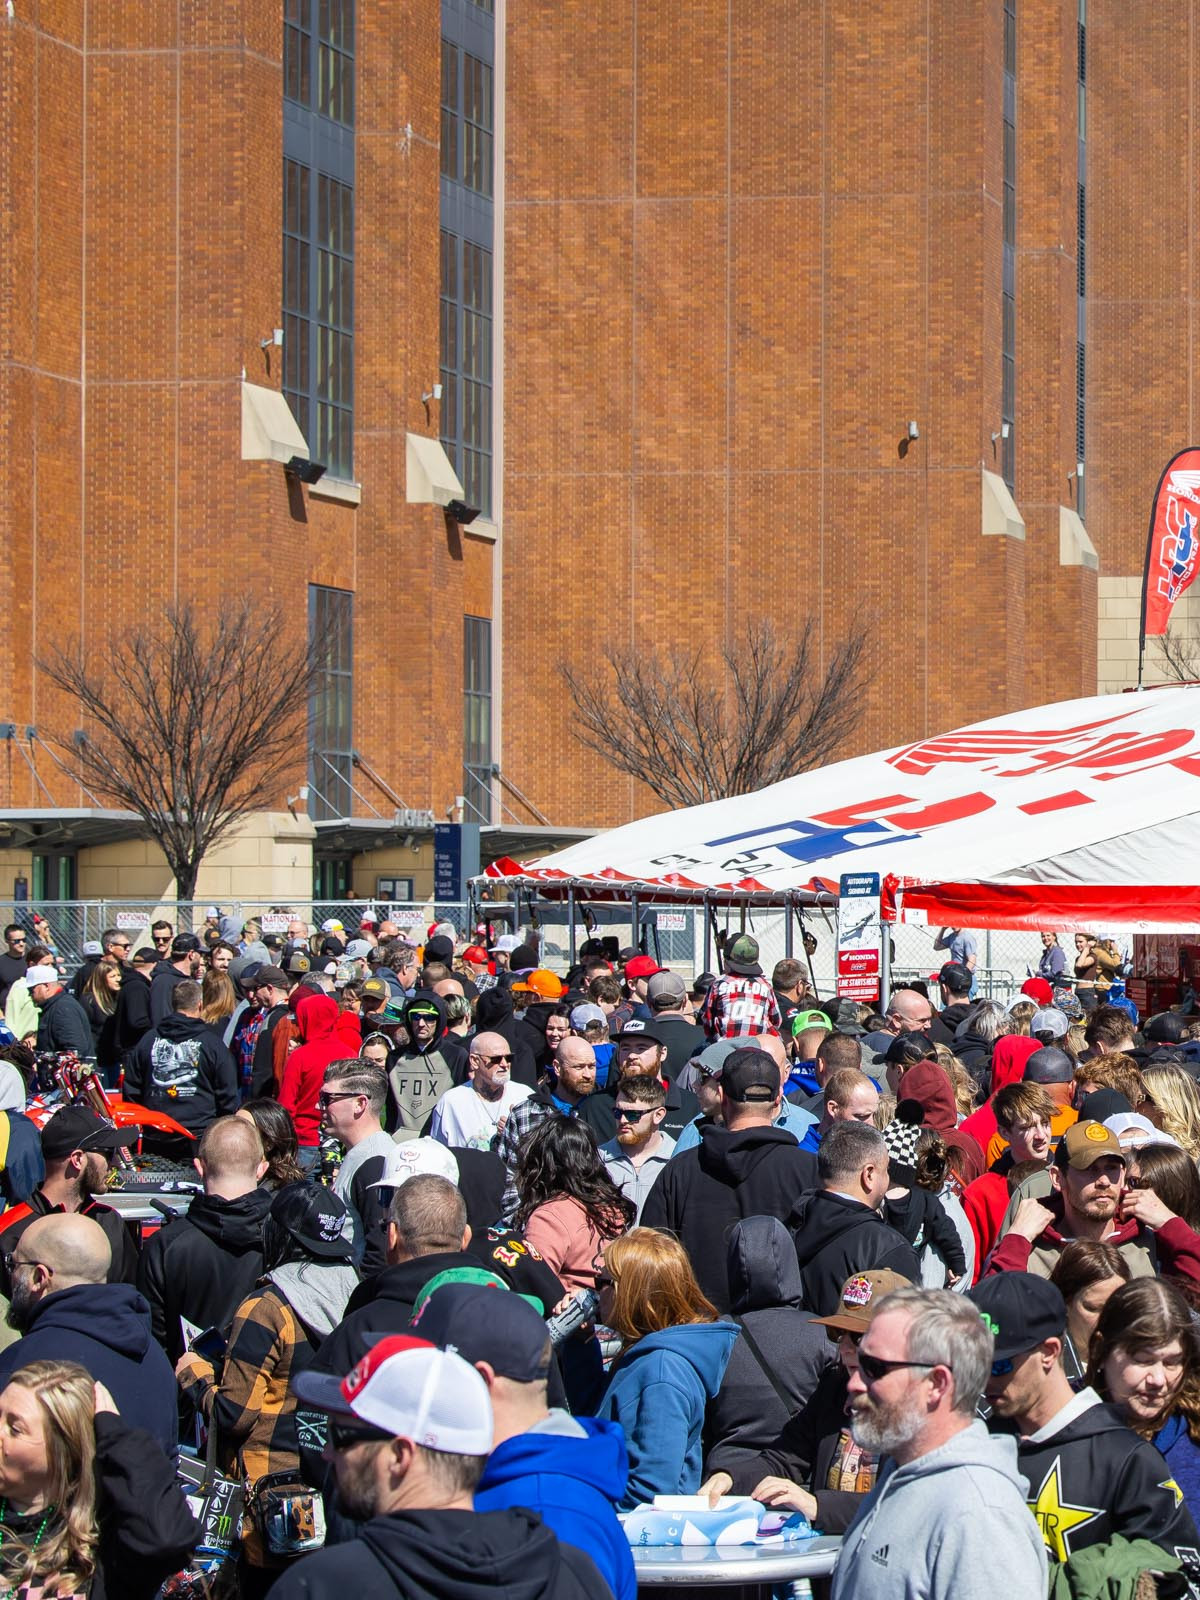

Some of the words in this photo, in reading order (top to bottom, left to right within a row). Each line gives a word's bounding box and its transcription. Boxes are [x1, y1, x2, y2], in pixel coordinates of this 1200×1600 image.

[849, 953, 877, 961] HONDA
[719, 979, 769, 995] SAYLOR
[399, 1079, 438, 1097] FOX
[298, 1431, 312, 1441] GS
